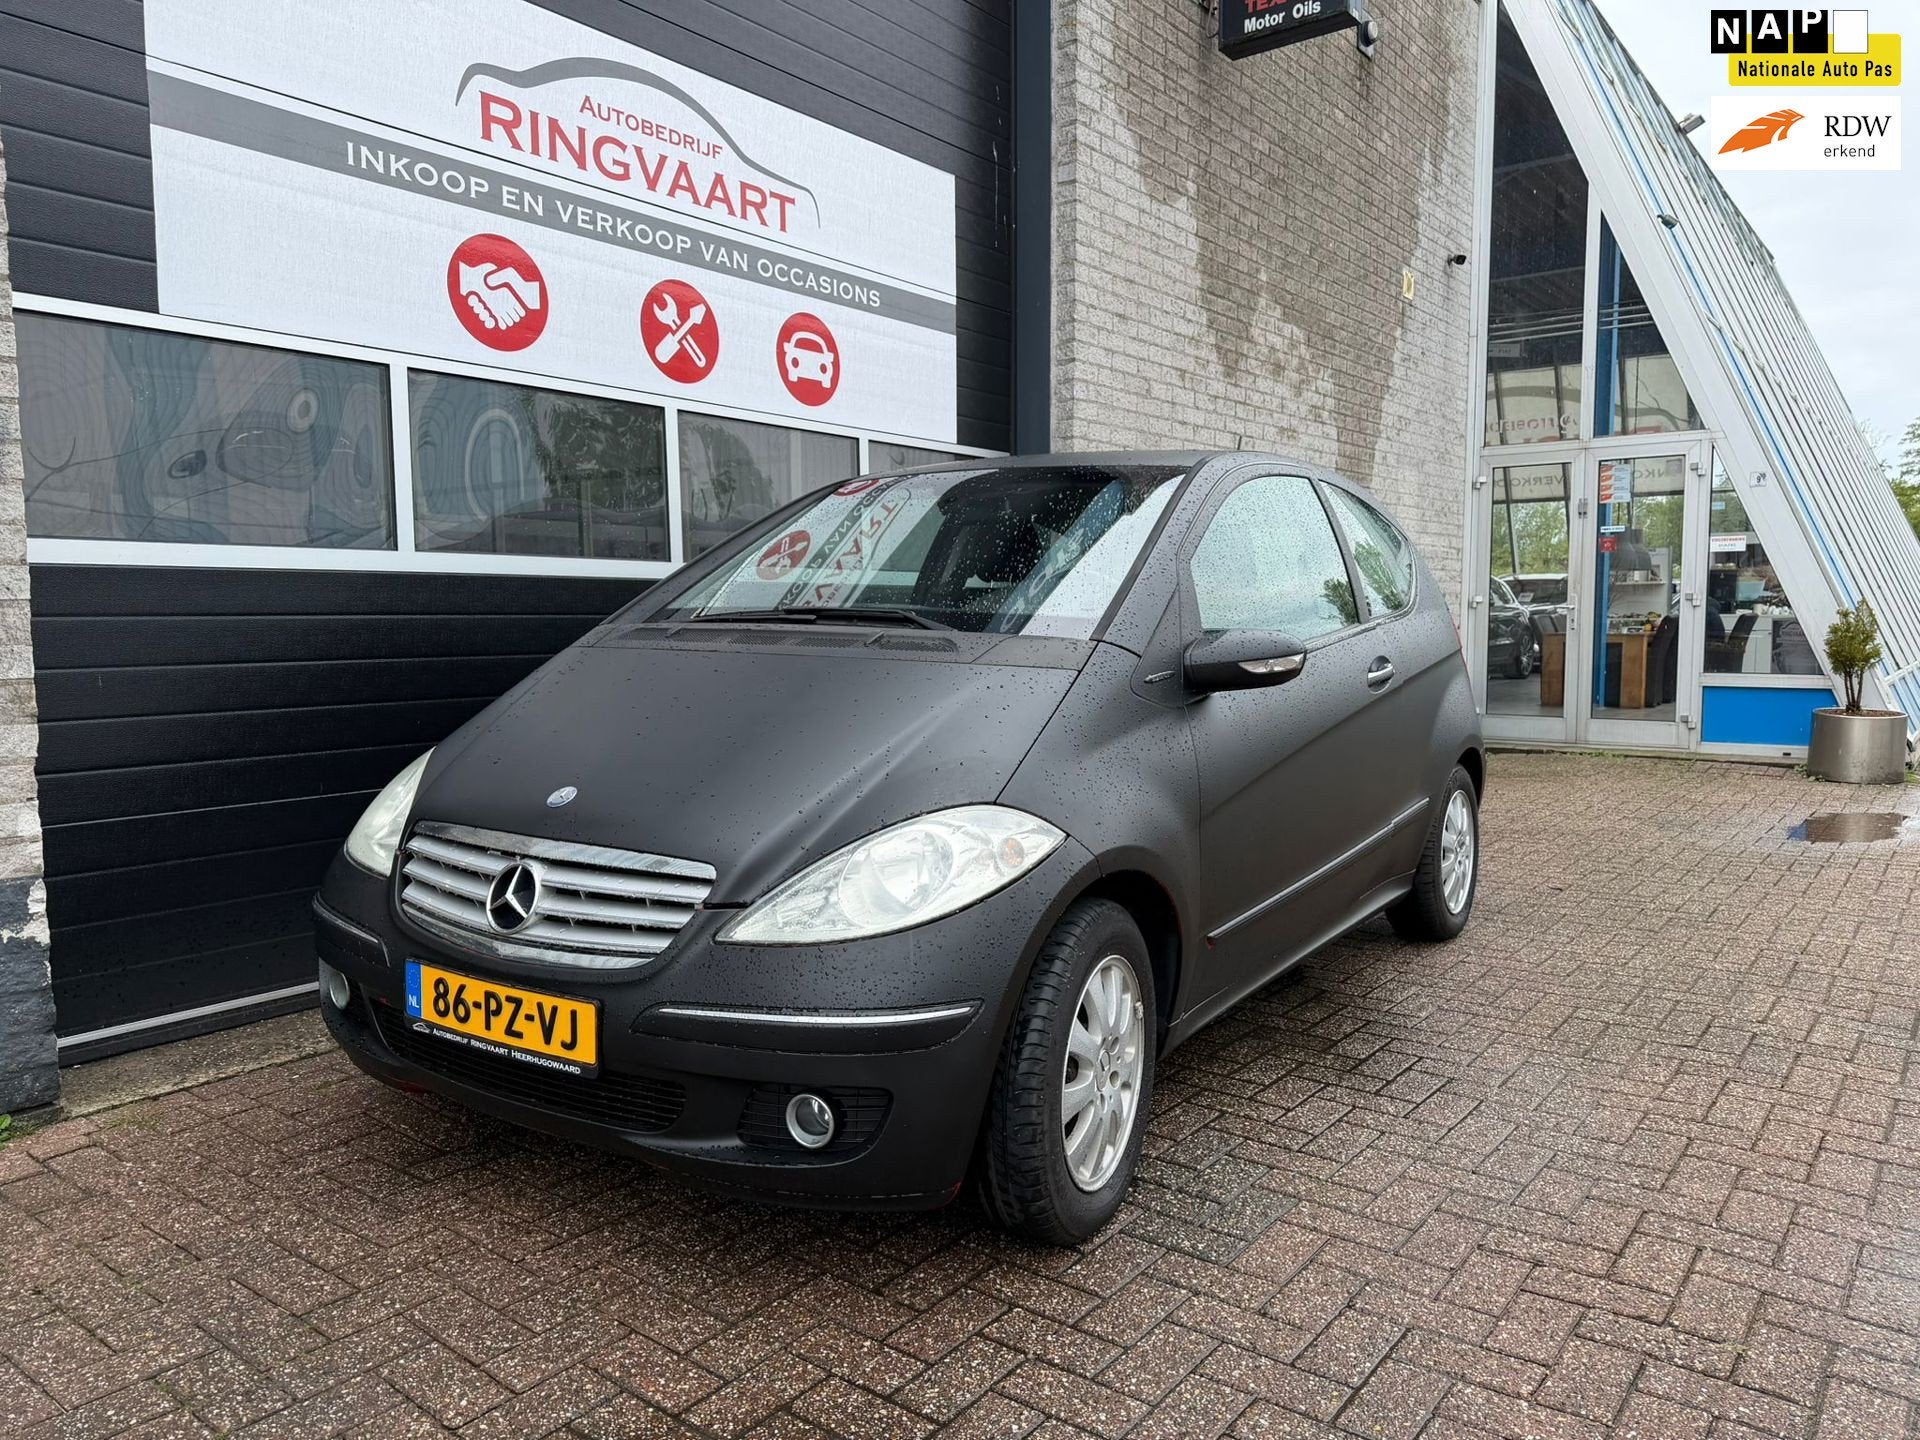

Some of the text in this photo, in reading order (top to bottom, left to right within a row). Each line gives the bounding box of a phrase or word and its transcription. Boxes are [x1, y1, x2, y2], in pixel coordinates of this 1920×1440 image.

[1243, 0, 1322, 34] Motor Oils
[478, 90, 796, 233] RINGVAART
[346, 141, 881, 307] INKOOP EN VERKOOP VAN OCCASIONS
[408, 994, 420, 1009] NL
[432, 976, 579, 1051] 86-PZ-VJ
[470, 1038, 509, 1057] RINGVAART
